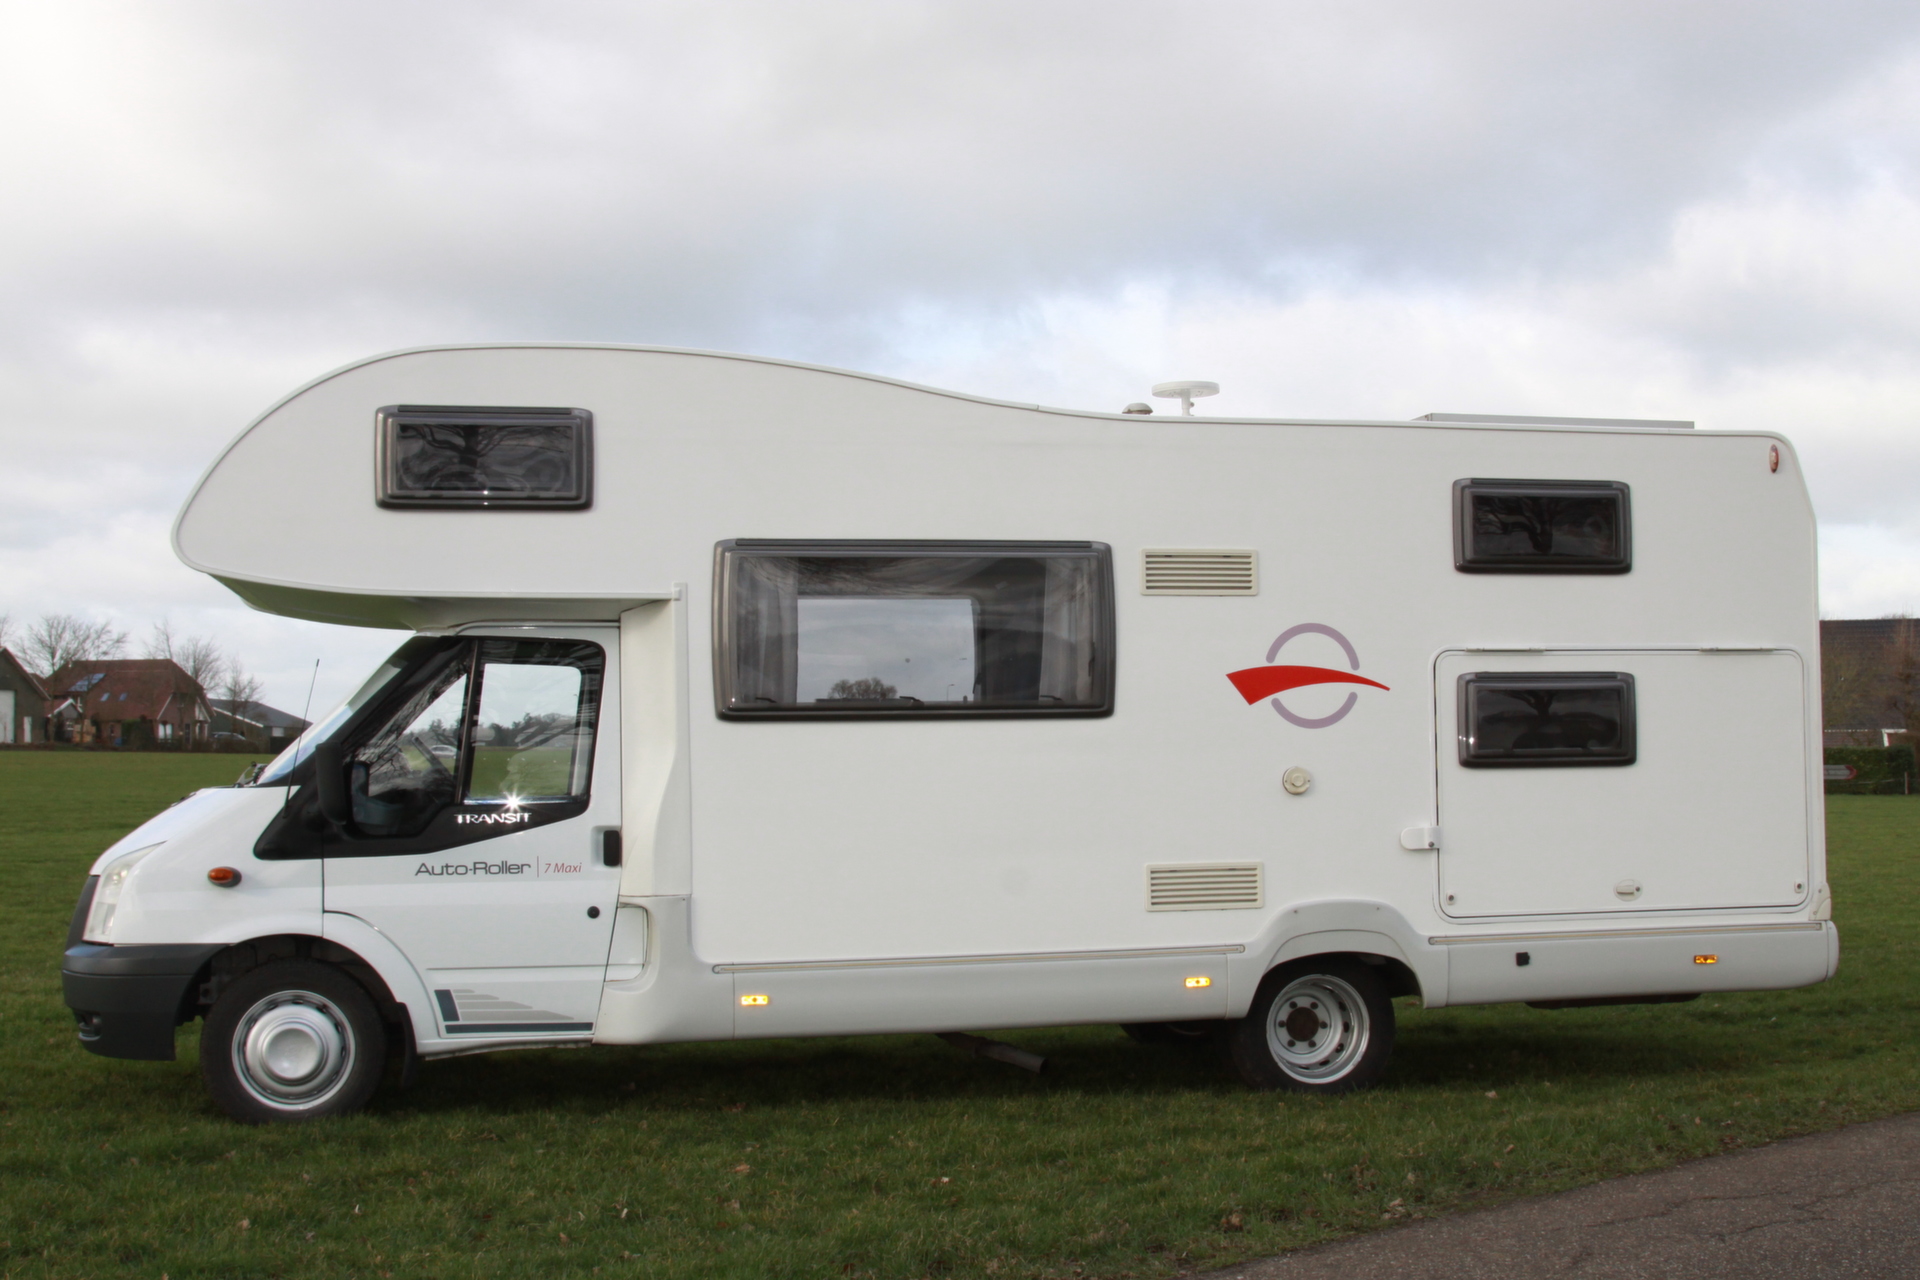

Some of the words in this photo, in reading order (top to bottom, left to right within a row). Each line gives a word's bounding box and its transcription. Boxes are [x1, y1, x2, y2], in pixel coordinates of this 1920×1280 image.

[454, 813, 532, 824] TRANSIT
[415, 861, 531, 876] Auto-Roller
[544, 863, 552, 873] 7
[553, 862, 582, 873] Maxi
